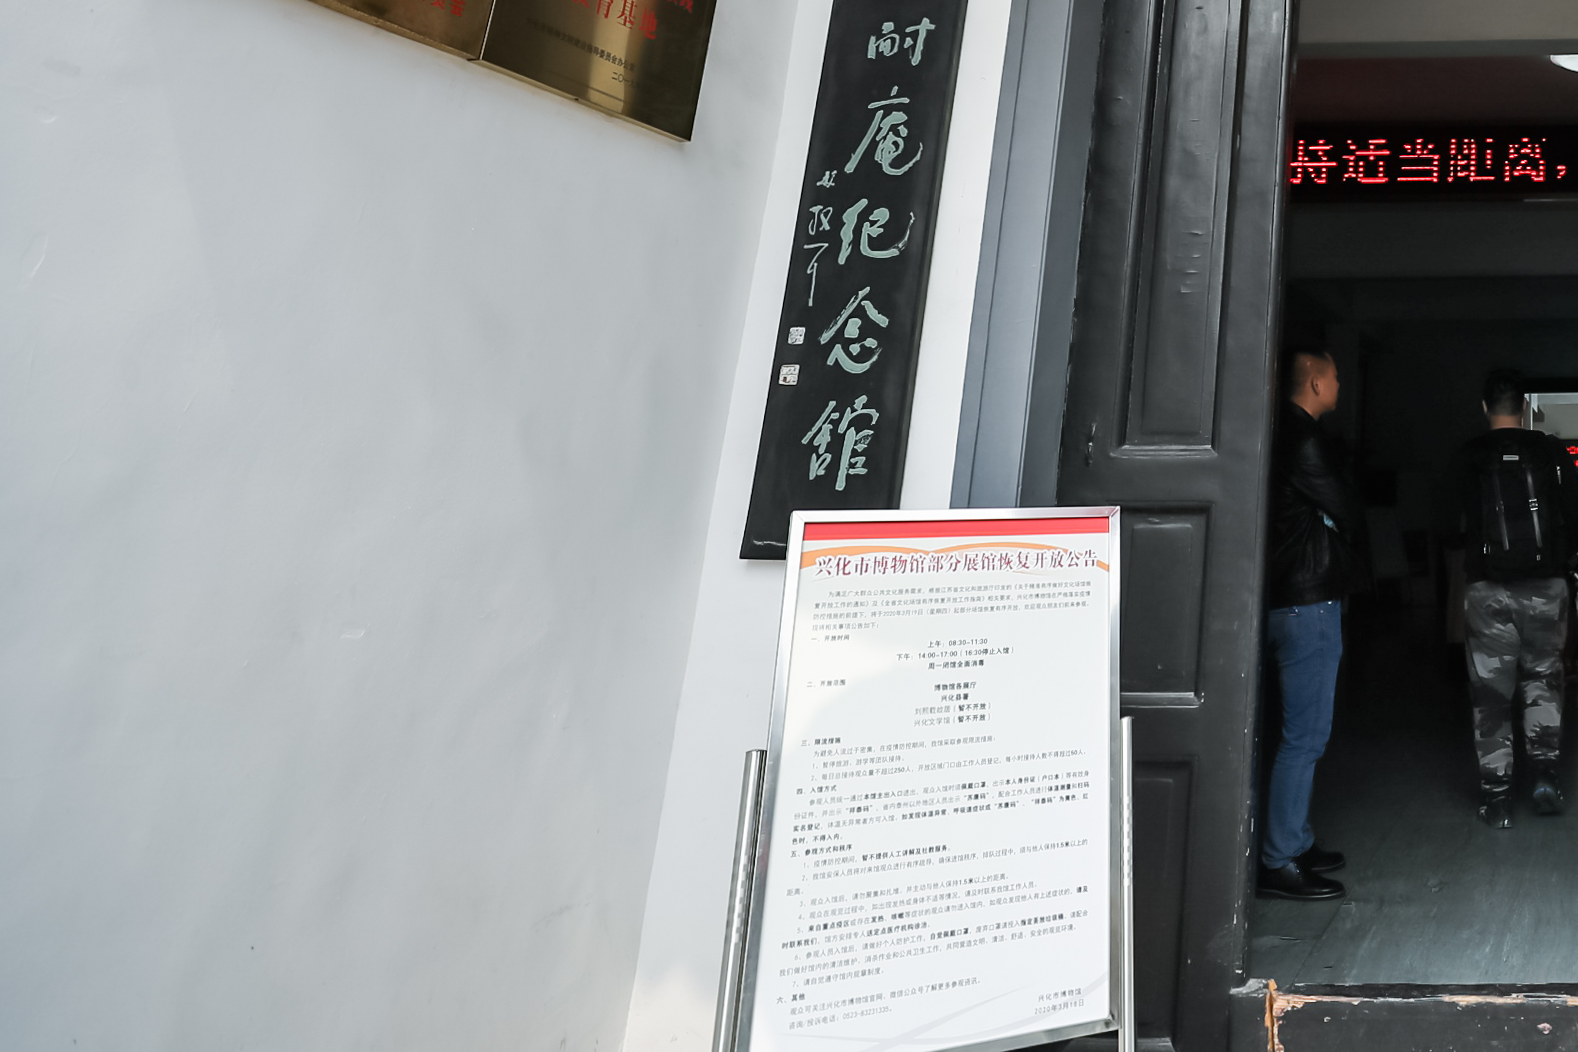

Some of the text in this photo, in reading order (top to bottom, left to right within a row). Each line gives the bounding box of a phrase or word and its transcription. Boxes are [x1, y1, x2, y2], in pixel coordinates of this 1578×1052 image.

[815, 549, 1097, 578] 兴化市博物馆部分展馆恢复开放公告
[928, 659, 985, 670] 周一闭馆全面消毒
[934, 681, 977, 691] 博物馆各展厅
[1038, 988, 1082, 1003] 兴化市博物馆
